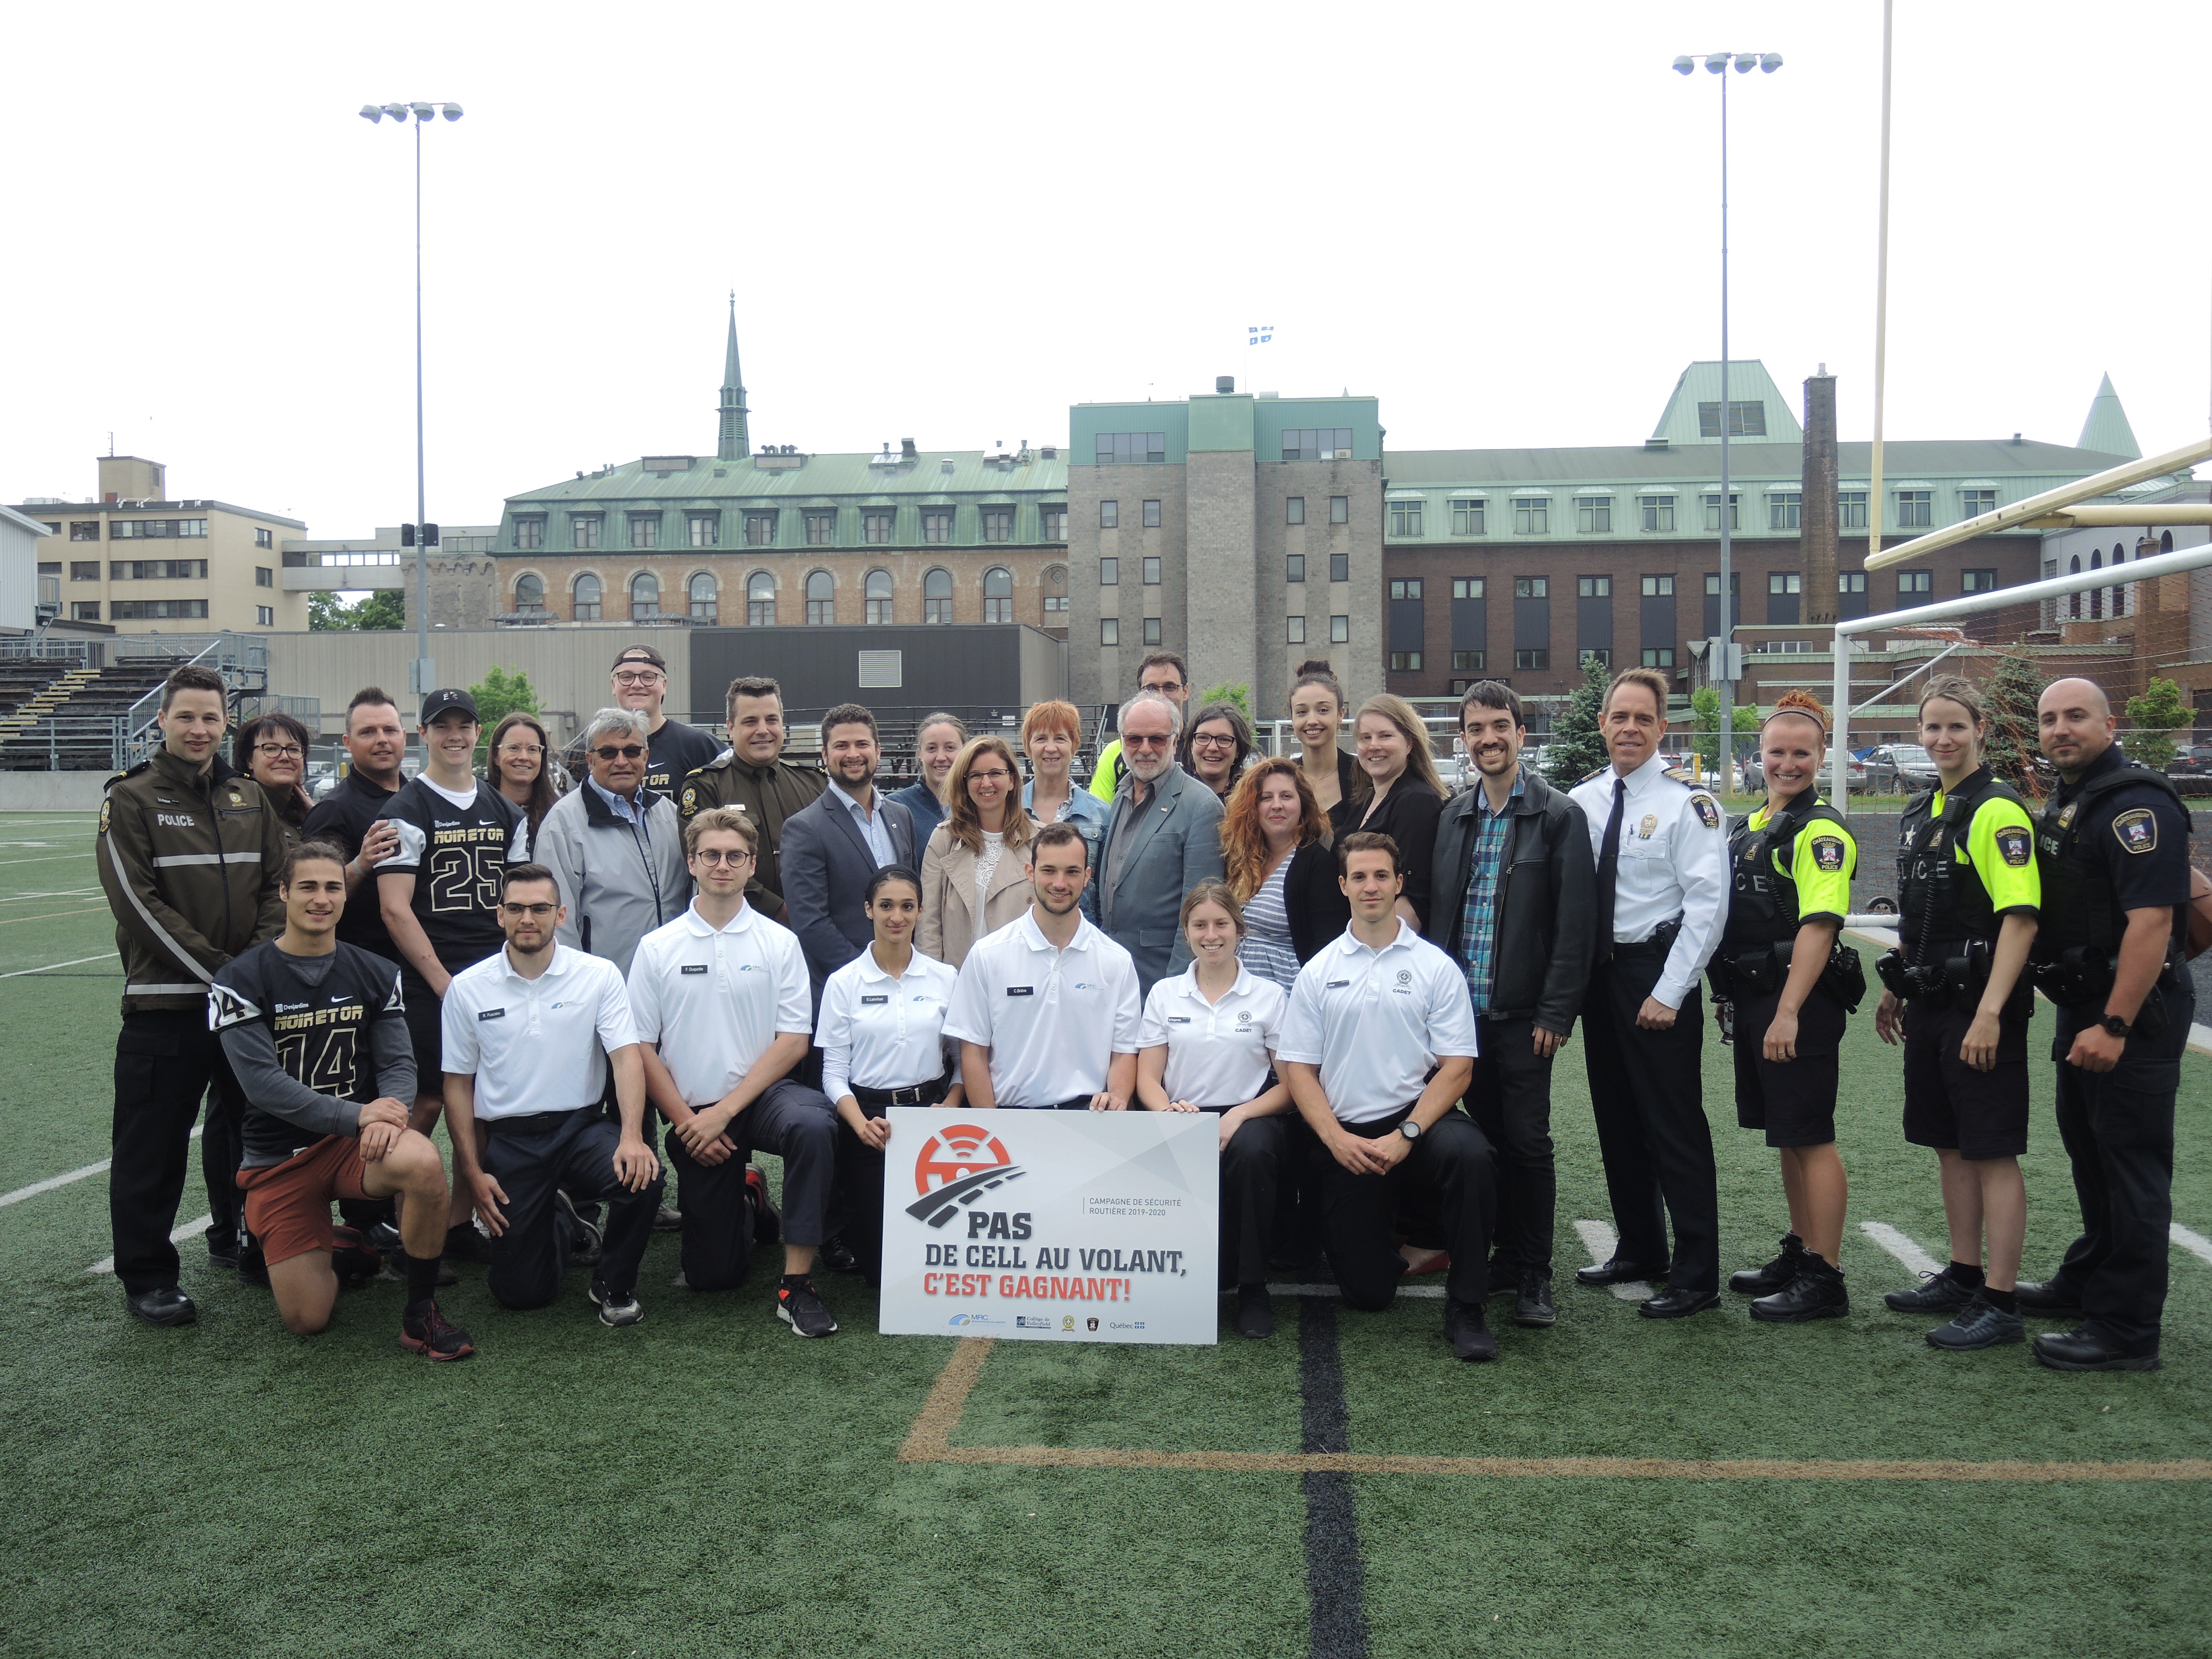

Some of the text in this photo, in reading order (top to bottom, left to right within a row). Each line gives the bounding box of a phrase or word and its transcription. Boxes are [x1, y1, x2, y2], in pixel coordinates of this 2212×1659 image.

[158, 813, 195, 827] POLICE
[430, 847, 504, 911] 25
[283, 1001, 309, 1011] Desjardins
[275, 1027, 357, 1098] 14
[1089, 1206, 1126, 1215] ROUTIÈRE
[1145, 1197, 1182, 1207] SÉCURITÉ
[967, 1211, 1032, 1240] PAS
[925, 1244, 1186, 1277] DE CELL AU VOLANT,
[924, 1272, 1130, 1301] C'EST GAGNANT!
